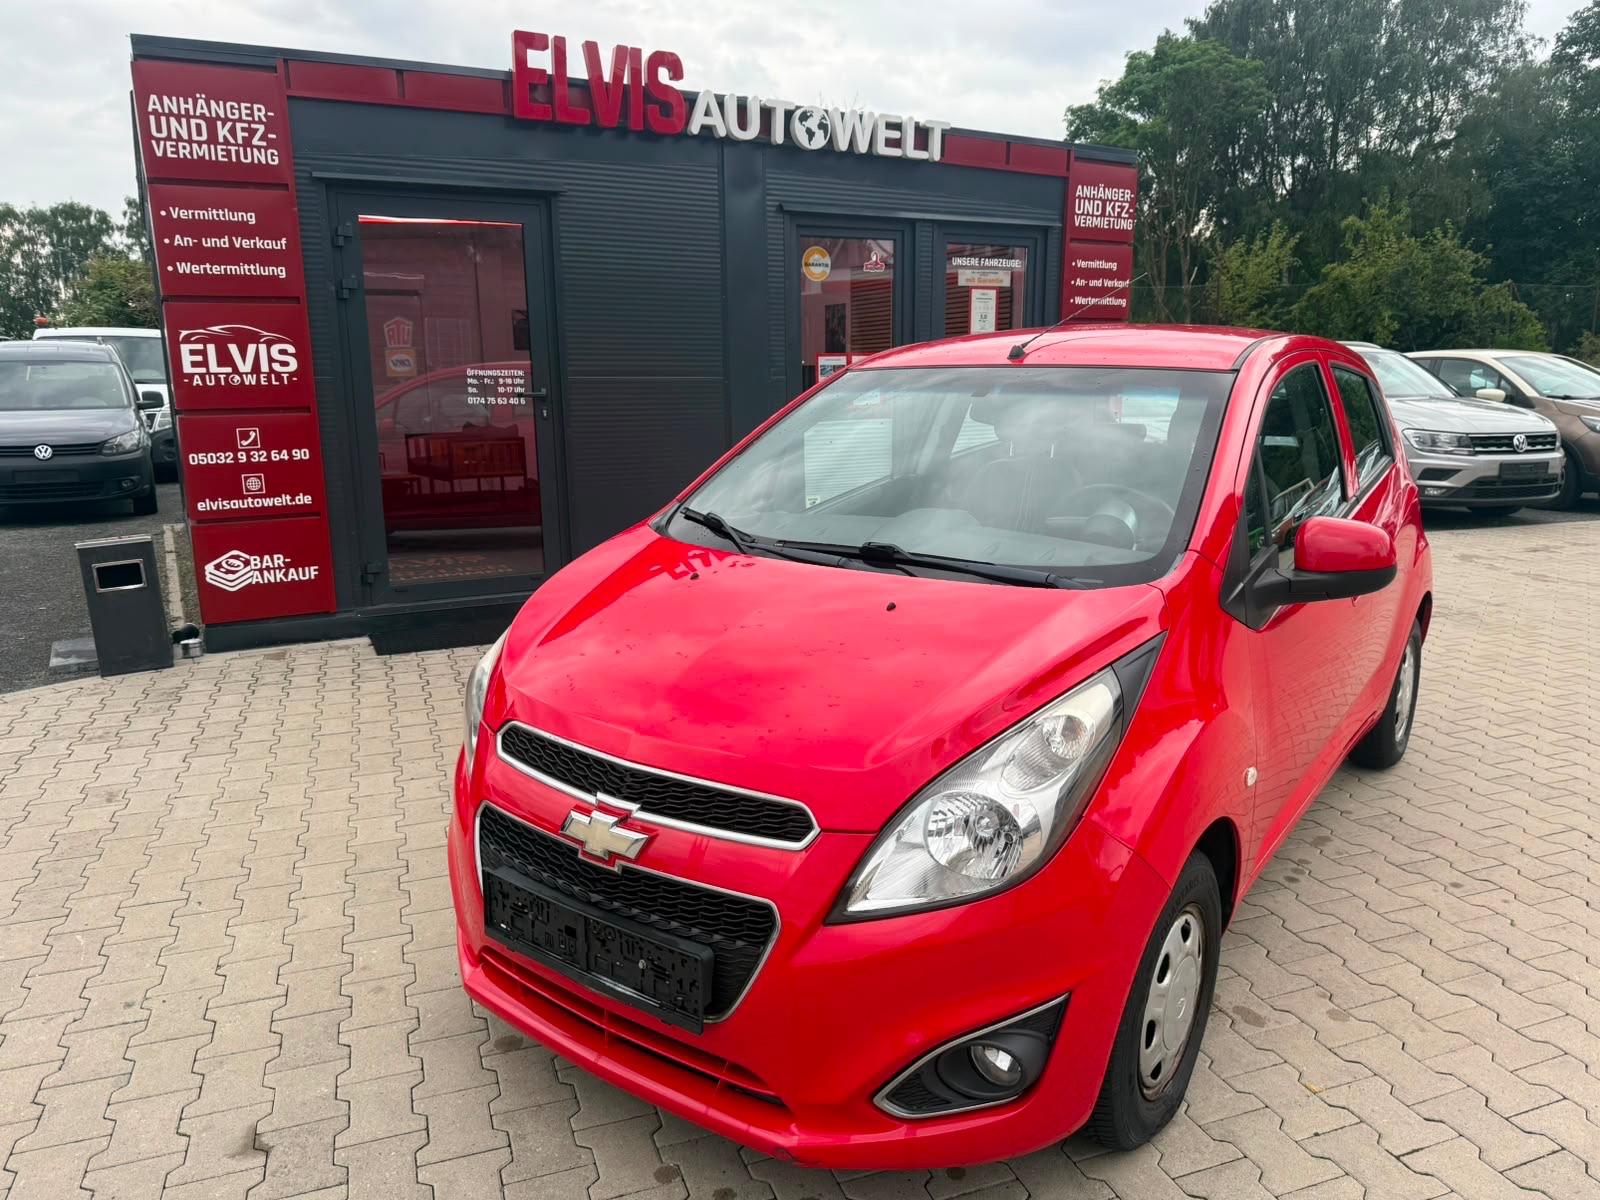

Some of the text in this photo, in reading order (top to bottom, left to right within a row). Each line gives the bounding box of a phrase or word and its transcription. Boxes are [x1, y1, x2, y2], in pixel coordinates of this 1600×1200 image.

[511, 29, 951, 161] ELVIS AUTOWELT
[148, 93, 274, 121] ANHÄNGER-
[149, 115, 277, 146] UND KFZ-
[151, 140, 279, 165] VERMIETUNG
[1076, 184, 1134, 201] ANHÄNGER-
[169, 207, 256, 224] Vermittlung
[1075, 198, 1133, 218] UND KFZ-
[1074, 215, 1133, 230] VERMIETUNG
[174, 234, 287, 250] An- und Verkauf
[176, 262, 286, 278] Wertermittlung
[952, 257, 979, 266] UNSERE
[1077, 259, 1117, 271] Vermittlung
[1075, 278, 1088, 286] An-
[1089, 278, 1102, 287] und
[180, 343, 298, 373] ELVIS
[466, 368, 525, 376] ÖFFNUNGSZEITEN:
[34, 444, 53, 460] VW
[1513, 434, 1528, 453] VW
[189, 449, 310, 465] 05032 9 32 64 90
[197, 493, 312, 511] elvisautowelt.de
[250, 554, 291, 569] BAR-
[252, 566, 319, 584] ANKAUF
